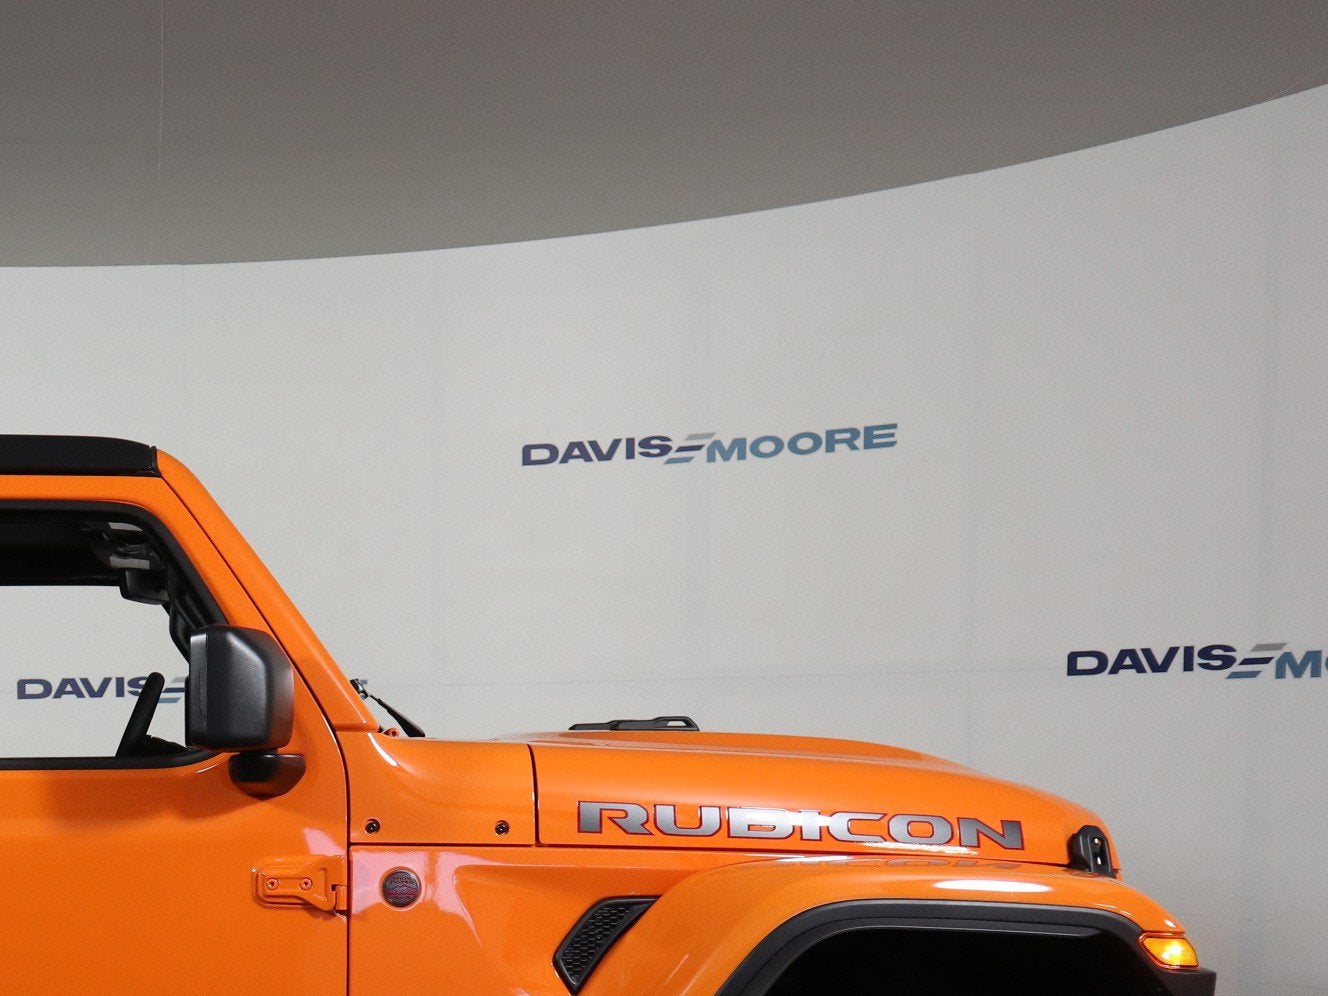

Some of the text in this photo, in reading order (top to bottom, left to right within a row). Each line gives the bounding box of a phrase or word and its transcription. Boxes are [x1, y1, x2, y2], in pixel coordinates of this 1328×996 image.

[522, 423, 898, 466] DAVIS MOORE
[1067, 644, 1328, 679] DAVIS M
[576, 800, 1024, 850] RUBICON
